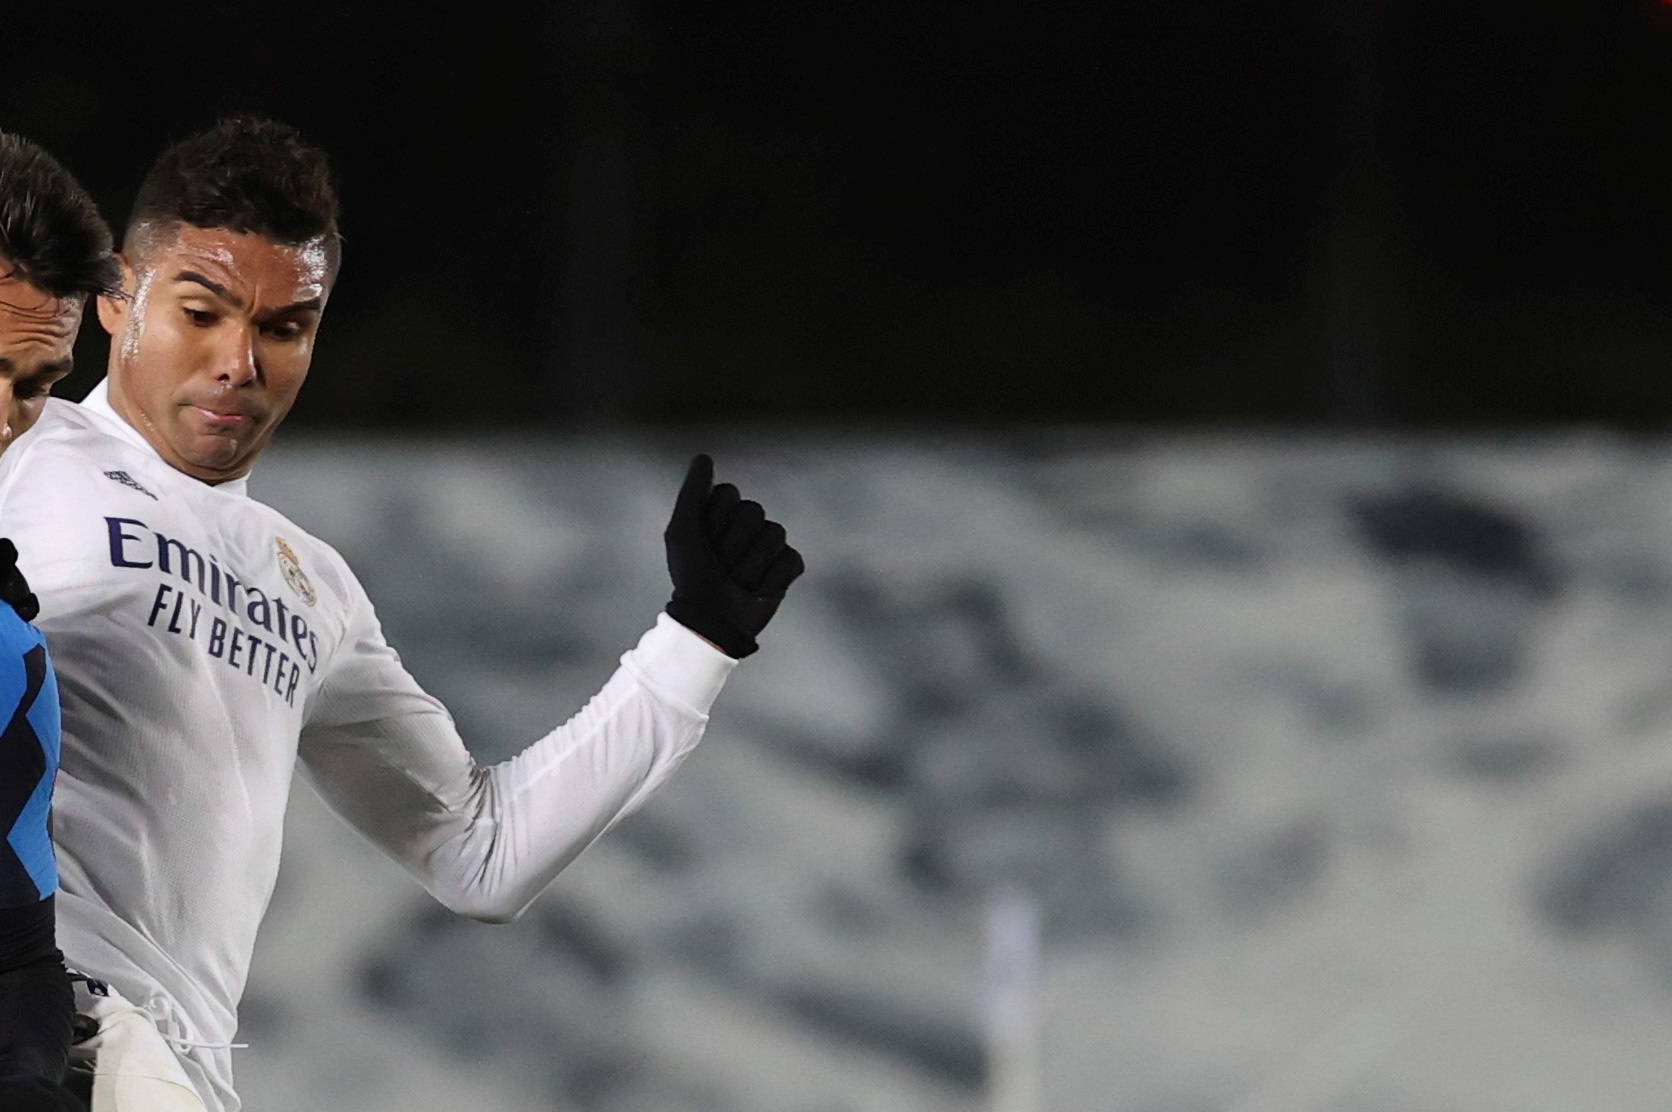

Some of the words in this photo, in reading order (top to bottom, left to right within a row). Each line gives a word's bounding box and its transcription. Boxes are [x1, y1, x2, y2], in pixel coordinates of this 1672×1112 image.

[103, 516, 319, 675] Emirates
[146, 583, 201, 639] FLY
[207, 616, 300, 708] BETTER
